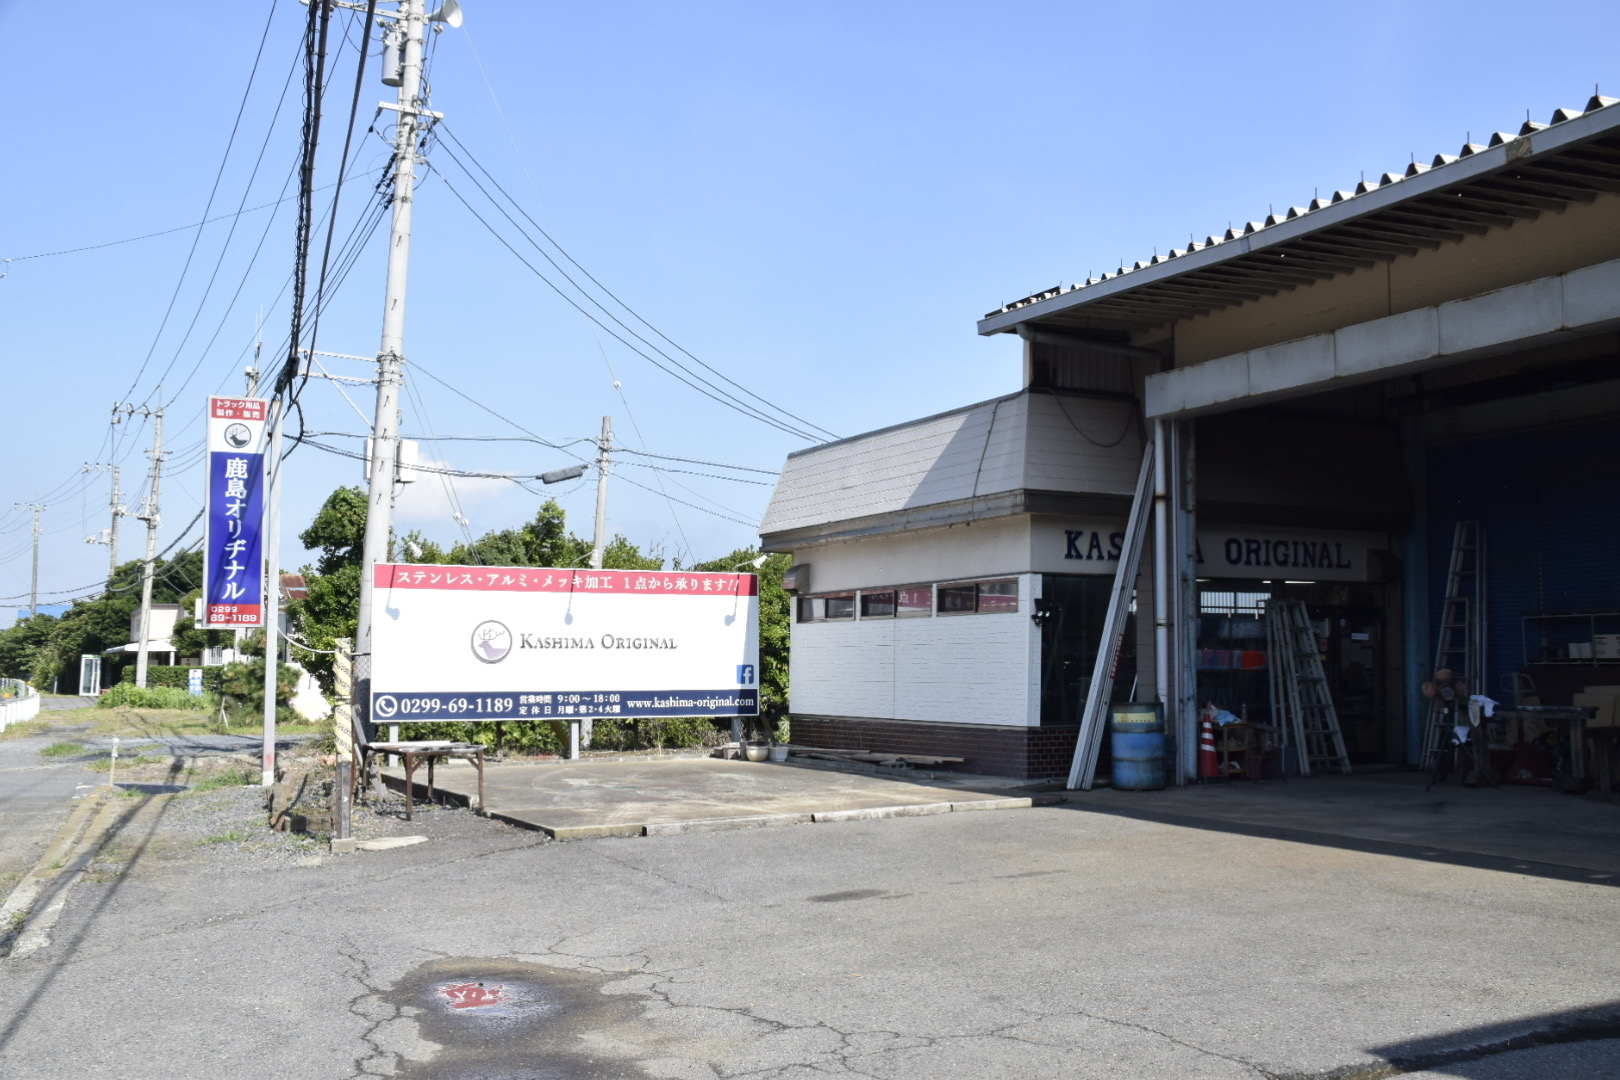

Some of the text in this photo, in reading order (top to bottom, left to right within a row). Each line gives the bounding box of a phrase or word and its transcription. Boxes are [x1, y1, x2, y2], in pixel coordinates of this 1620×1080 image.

[217, 400, 261, 410] トラック用品
[222, 457, 248, 600] 鹿島オリヂナル
[1224, 537, 1352, 569] ORIGINAL
[397, 571, 613, 590] ステンレス・アルミ・メッキ加工
[210, 614, 257, 622] 69-1189
[400, 697, 513, 713] 0299-69-1189
[519, 694, 552, 704] 営業時間
[626, 696, 754, 710] www.kashima-original.com
[519, 706, 552, 715] 定休日
